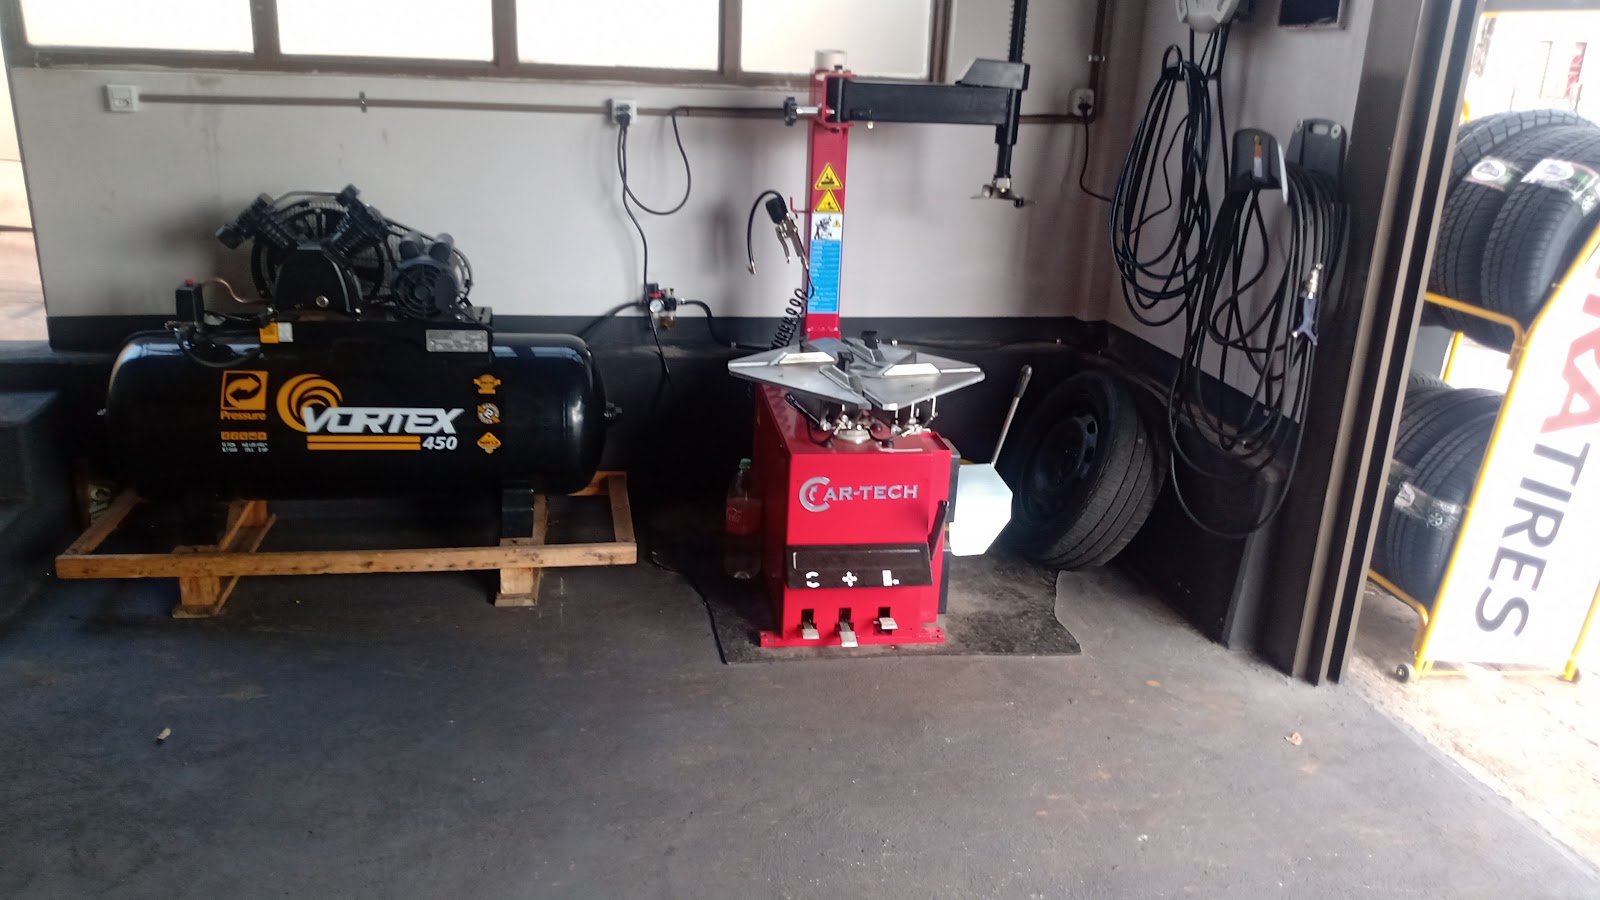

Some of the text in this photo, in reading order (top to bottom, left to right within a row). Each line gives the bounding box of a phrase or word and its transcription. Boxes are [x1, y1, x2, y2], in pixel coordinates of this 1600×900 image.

[219, 411, 267, 421] Pressure
[302, 406, 465, 434] VORTEX
[421, 435, 458, 451] 450
[798, 475, 919, 513] CAR-TECH
[1475, 441, 1591, 638] TIRES
